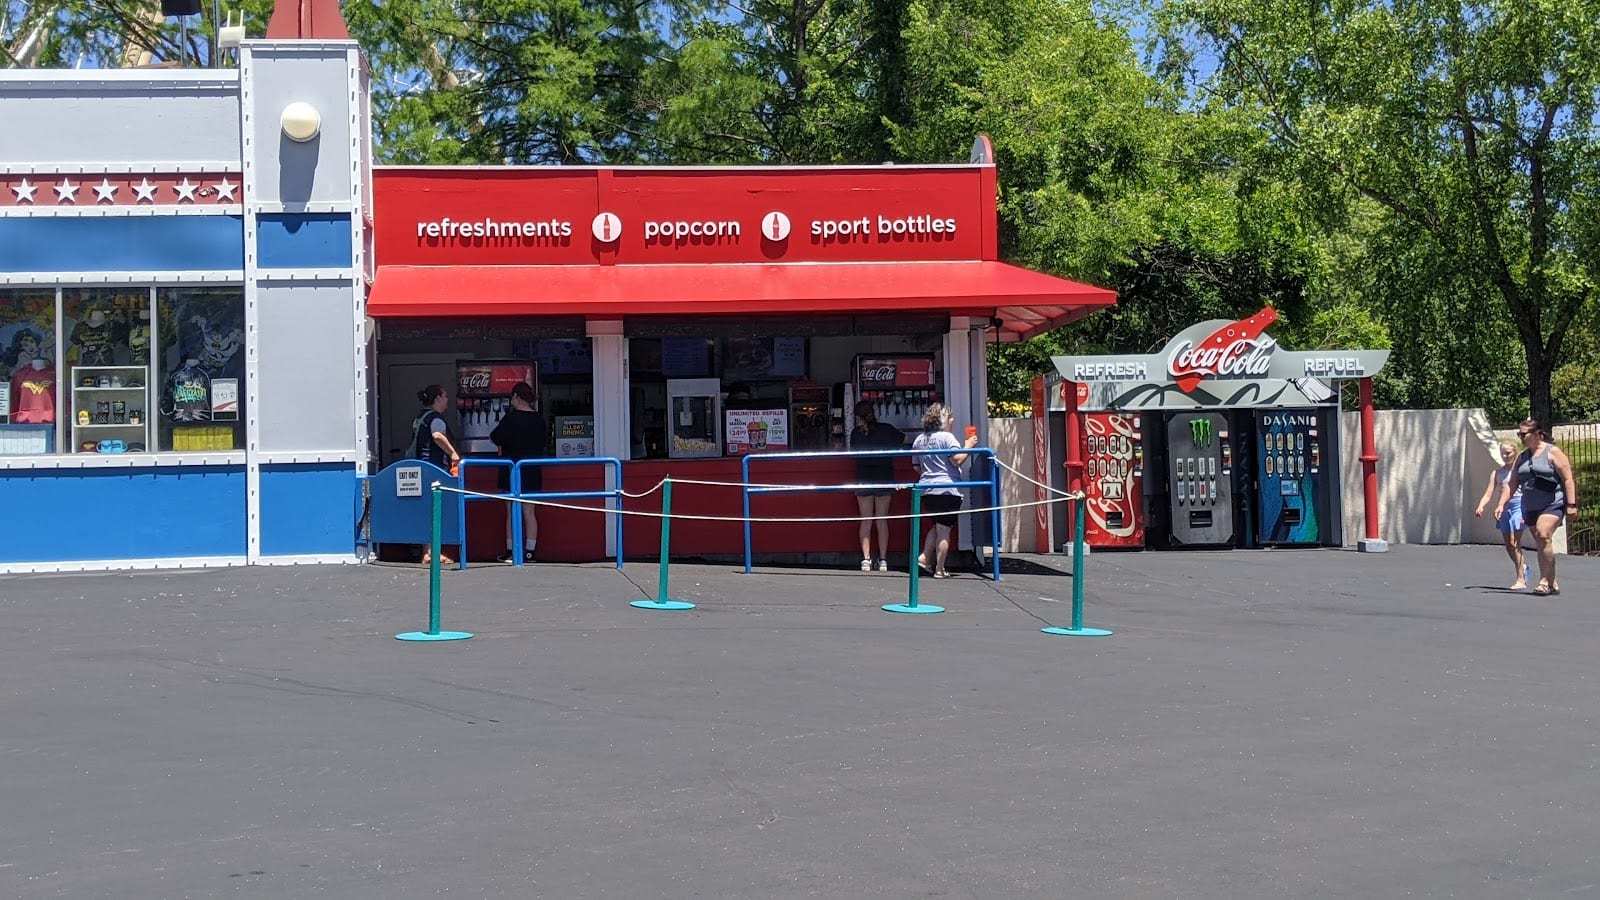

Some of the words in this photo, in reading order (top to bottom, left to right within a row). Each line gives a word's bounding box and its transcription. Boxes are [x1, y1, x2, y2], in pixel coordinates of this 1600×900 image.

[417, 218, 571, 237] refreshments
[645, 221, 740, 239] popcorn
[810, 216, 871, 239] sport
[877, 214, 957, 235] bottles
[1167, 338, 1276, 376] Coca-Cola
[1074, 361, 1147, 379] REFRESH
[1304, 358, 1365, 376] REFUEL
[1263, 414, 1310, 427] DASANI
[399, 472, 408, 480] EXIT
